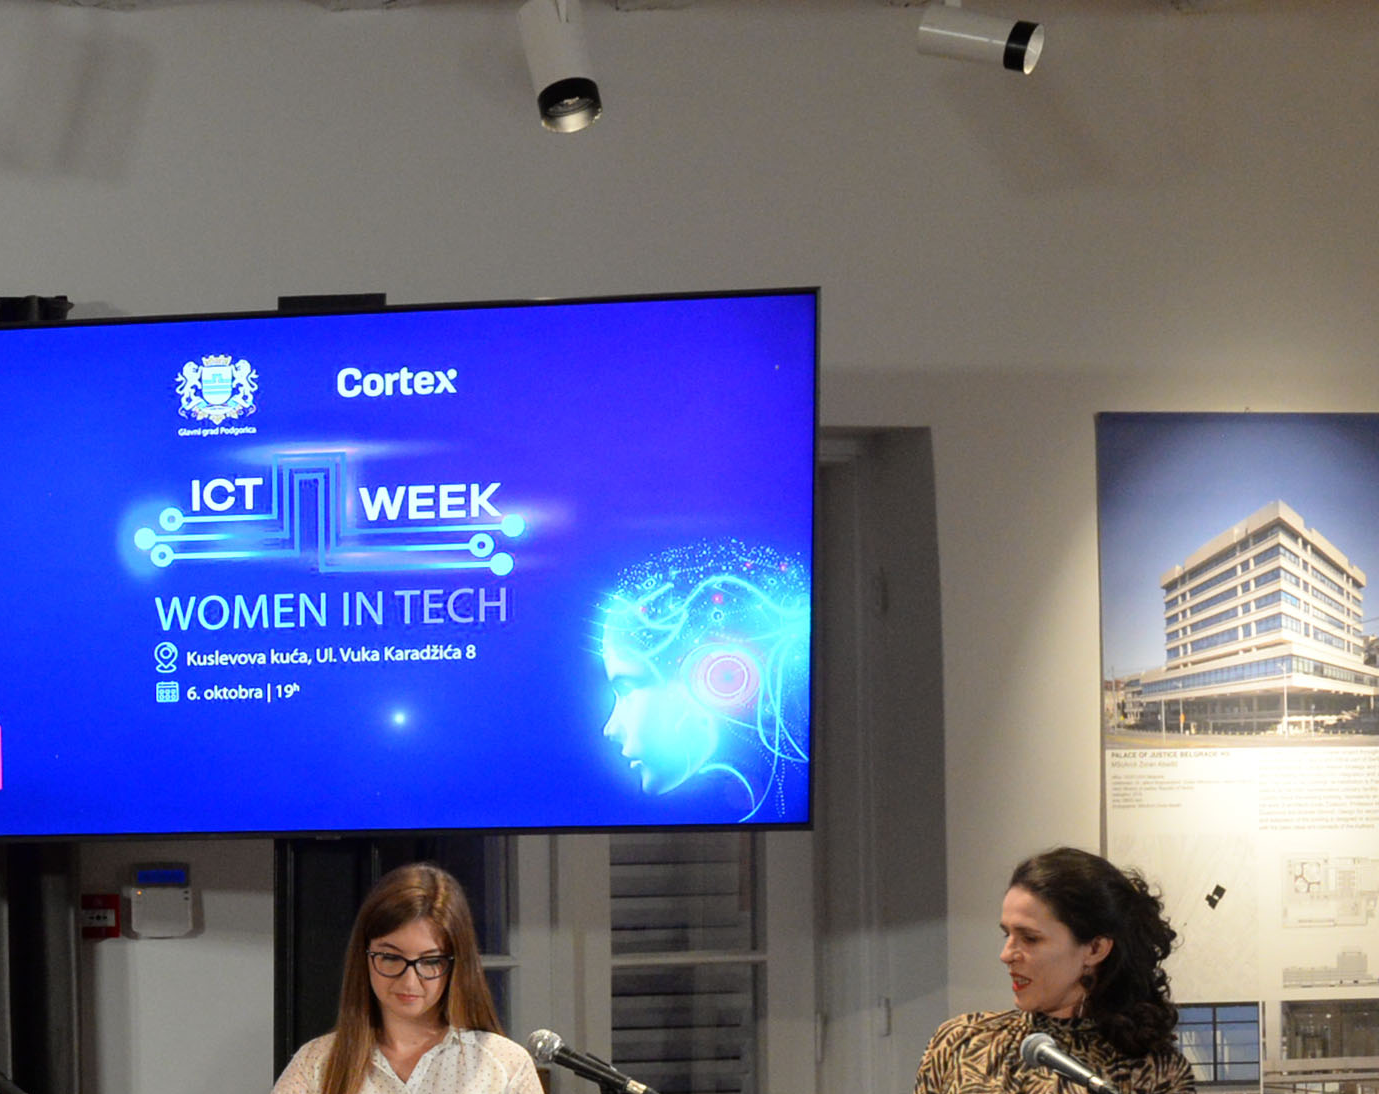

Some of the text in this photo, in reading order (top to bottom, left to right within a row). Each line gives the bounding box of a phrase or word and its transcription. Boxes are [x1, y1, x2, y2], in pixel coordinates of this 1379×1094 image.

[337, 366, 458, 398] Cortex
[177, 425, 257, 437] Glavni grad Podgorica
[191, 477, 502, 521] ICT WEEK
[154, 586, 507, 631] WOMEN IN TECH
[186, 643, 477, 668] Kuslevova kuća, Ul. Vuka Karadžića 8
[186, 686, 200, 701] 6.
[203, 684, 263, 701] oktobra
